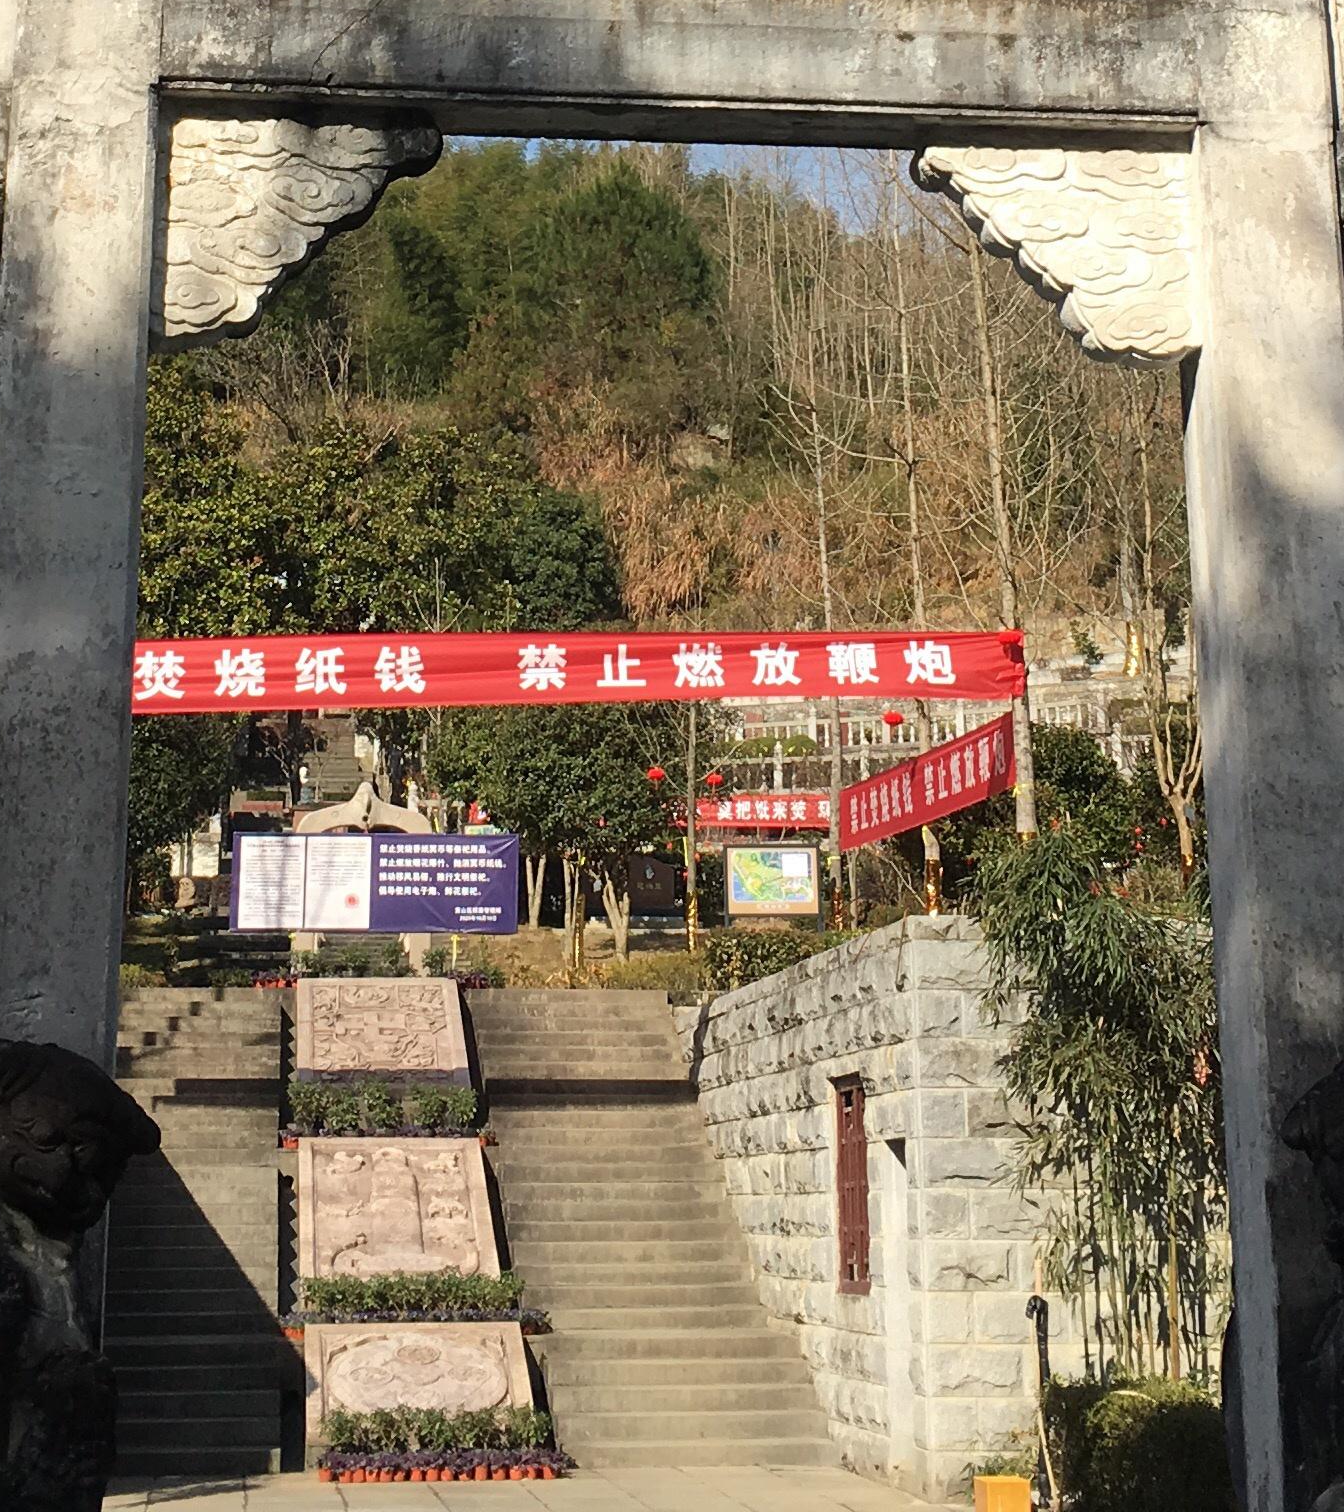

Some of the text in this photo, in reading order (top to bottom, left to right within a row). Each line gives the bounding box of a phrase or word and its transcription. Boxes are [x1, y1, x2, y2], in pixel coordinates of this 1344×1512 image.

[133, 641, 957, 701] 焚烧纸钱 禁止燃放鞭炮
[850, 728, 1006, 835] 禁止焚烧纸钱 禁止燃放鞭炮
